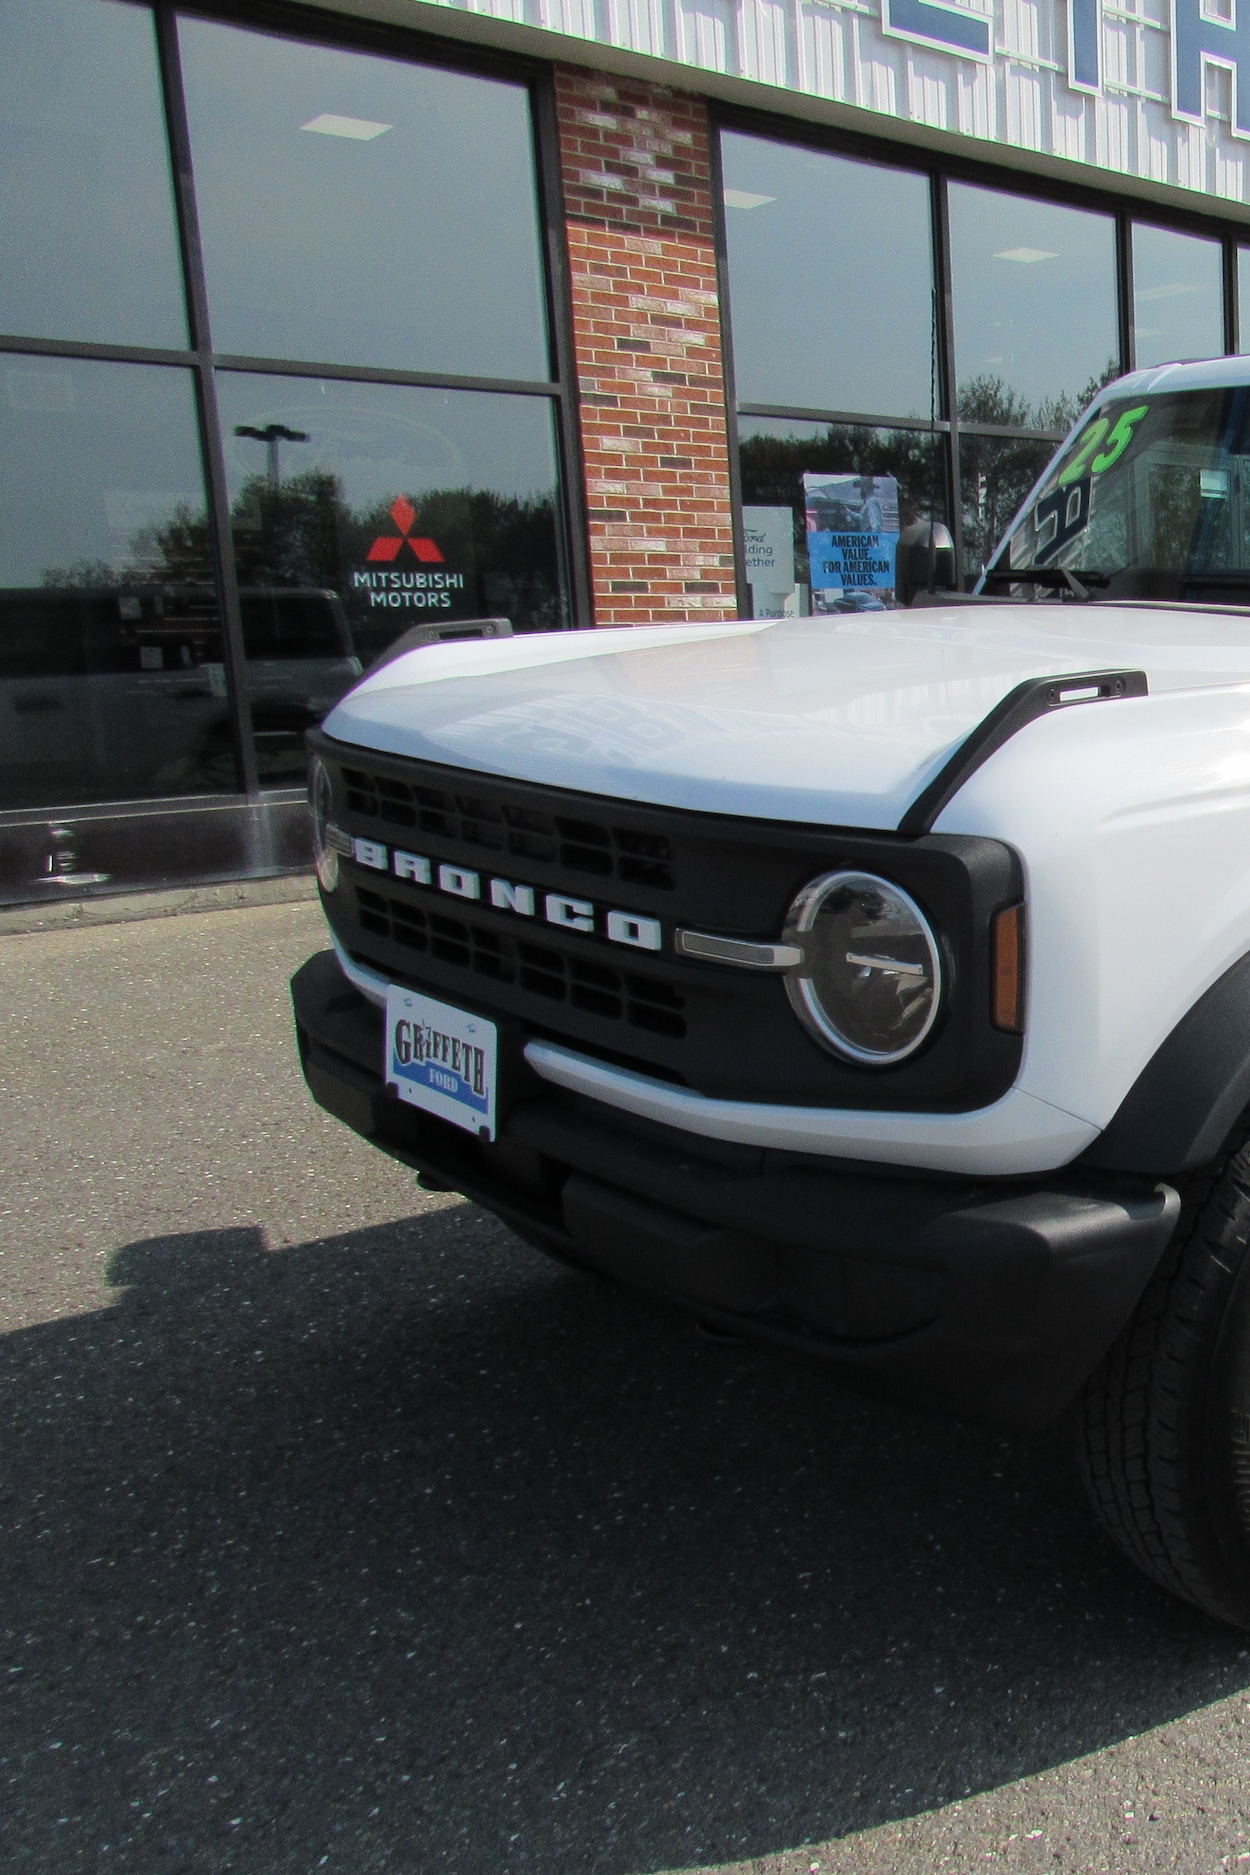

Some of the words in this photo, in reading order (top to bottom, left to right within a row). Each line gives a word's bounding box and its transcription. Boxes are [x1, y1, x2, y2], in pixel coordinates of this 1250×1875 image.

[1058, 405, 1150, 486] 25
[831, 536, 879, 547] AMERICAN
[841, 548, 873, 561] VALUE.
[823, 561, 840, 573] FOR
[843, 561, 890, 573] AMERICAN
[354, 572, 464, 588] MITSUBISHI
[840, 574, 877, 586] VALUES.
[370, 592, 452, 607] MOTORS
[355, 837, 663, 951] BRONCO
[429, 1068, 459, 1093] FORD
